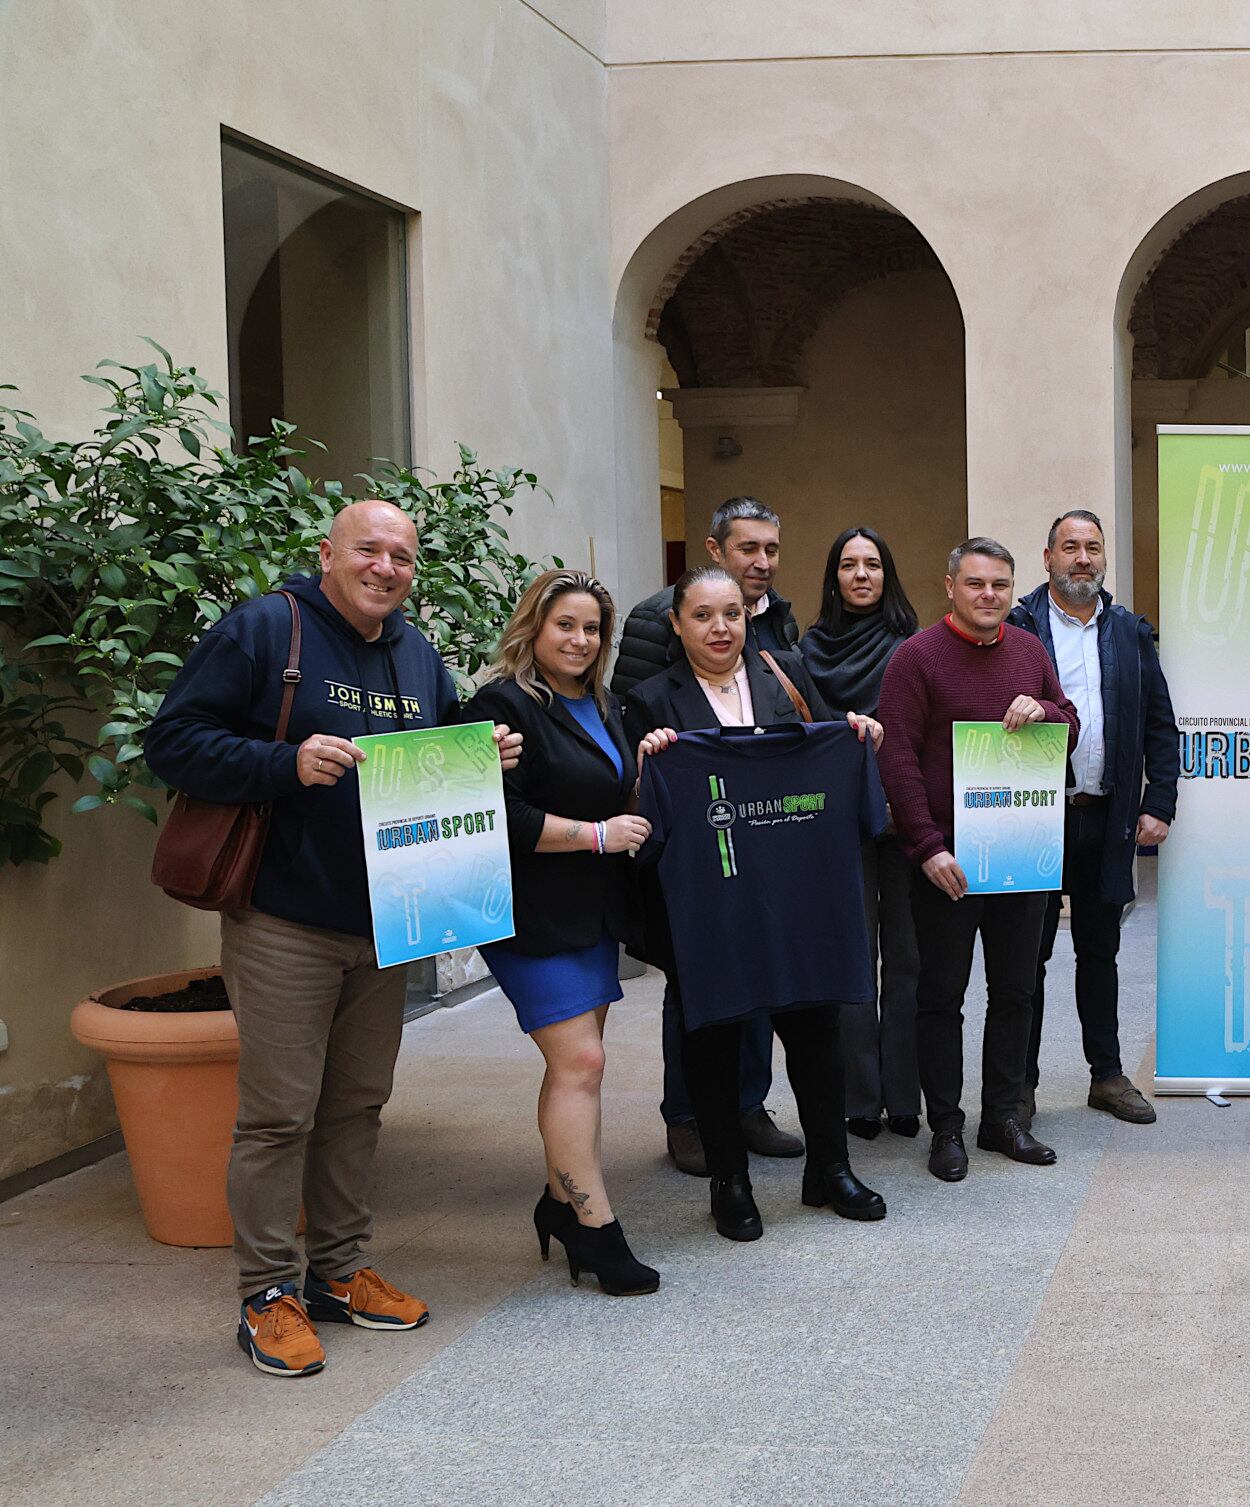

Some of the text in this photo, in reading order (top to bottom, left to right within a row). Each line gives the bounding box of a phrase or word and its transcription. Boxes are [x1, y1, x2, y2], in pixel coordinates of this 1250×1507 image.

[1178, 717, 1208, 727] CIRCUITO
[1209, 717, 1248, 727] PROVINCIAL
[965, 790, 1057, 808] URBAN SPORT
[378, 819, 440, 851] URBAN
[441, 809, 496, 839] SPORT
